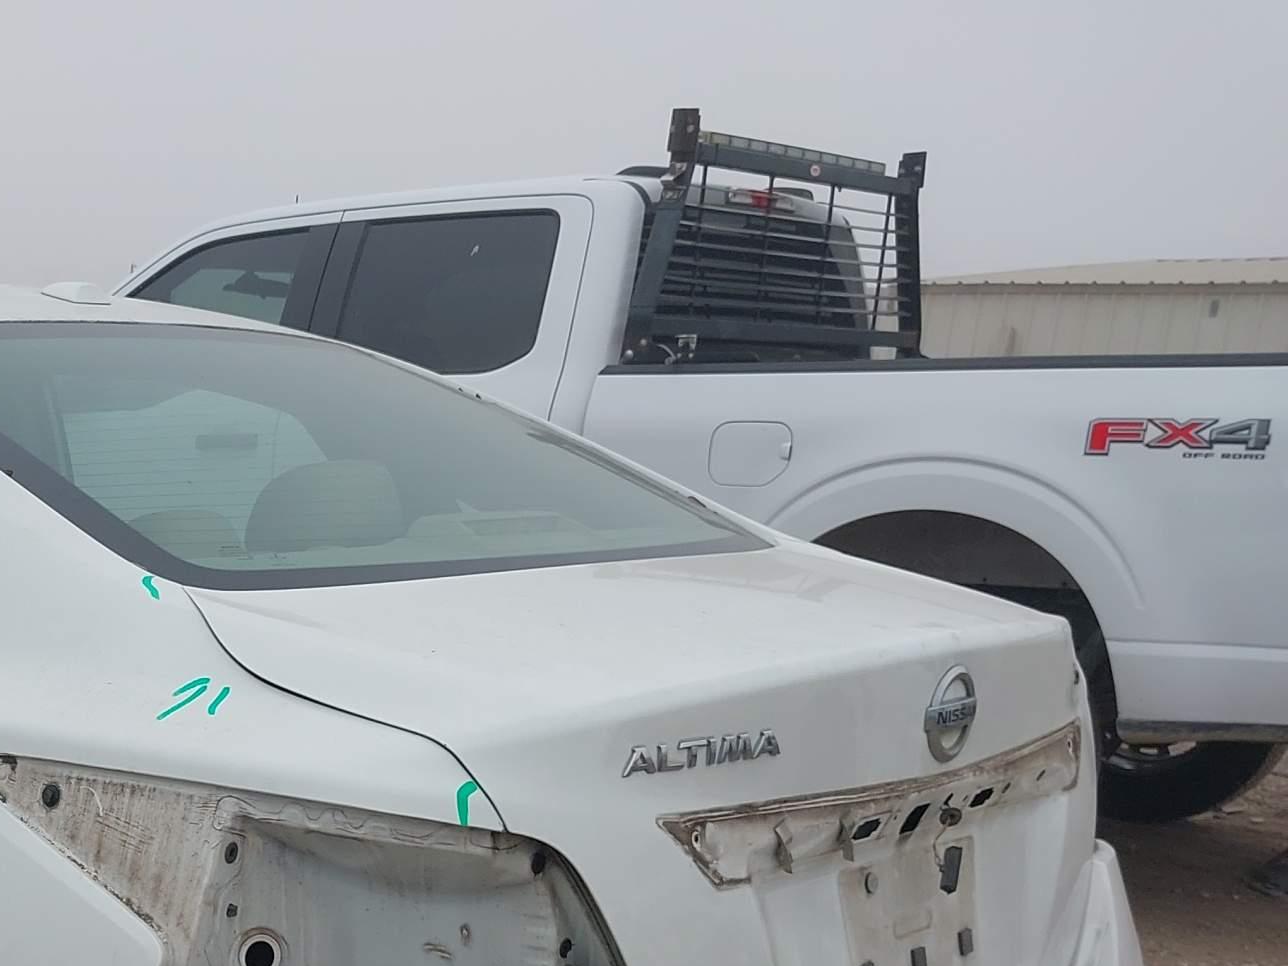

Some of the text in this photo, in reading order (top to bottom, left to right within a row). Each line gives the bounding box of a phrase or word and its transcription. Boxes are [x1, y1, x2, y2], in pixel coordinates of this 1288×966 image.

[1083, 417, 1272, 456] FX4
[1182, 452, 1266, 461] OFF ROAD
[621, 728, 781, 778] ALTIMA
